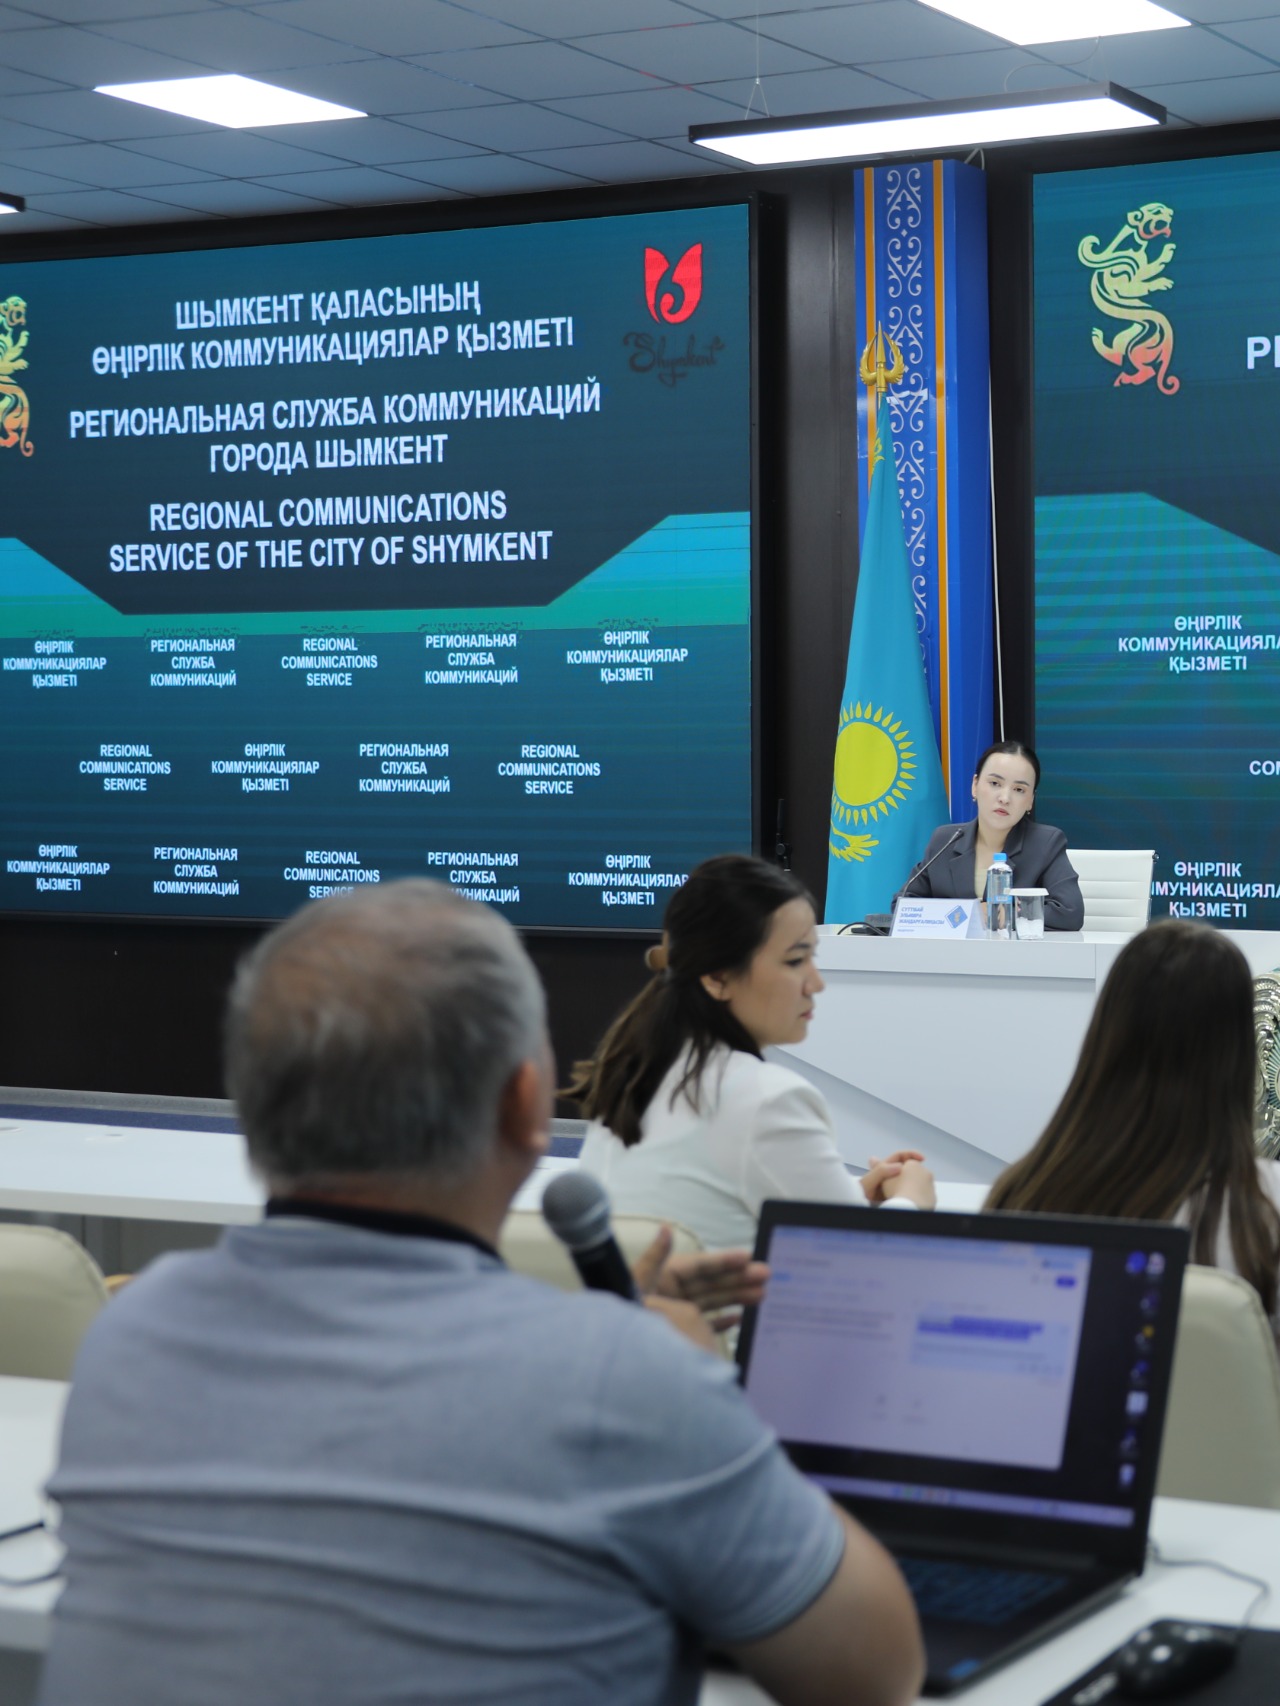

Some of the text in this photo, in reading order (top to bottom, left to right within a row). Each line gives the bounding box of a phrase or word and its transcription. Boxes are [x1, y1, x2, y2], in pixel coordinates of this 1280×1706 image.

[175, 280, 482, 330] ШЫМКЕНТ ҚАЛАСЫНЫҢ
[92, 316, 573, 378] ӨҢІРЛІК КОММУНИКАЦИЯЛАР ҚЫЗМЕТІ
[70, 376, 601, 439] РЕГИОНАЛЬНАЯ СЛУЖБА КОММУНИКАЦИЙ
[210, 433, 449, 476] ГОРОДА ШЫМКЕНТ
[150, 489, 507, 532] REGIONAL COMMUNICATIONS
[109, 530, 554, 573] SERVICE OF THE CITY OF SHYMKENT
[1174, 614, 1243, 633] ӨҢІРЛІК
[150, 638, 236, 653] РЕГИОНАЛЬНАЯ
[303, 637, 359, 652] REGIONAL
[425, 633, 517, 649] РЕГИОНАЛЬНАЯ
[603, 630, 650, 647] ӨҢІРЛІК
[34, 640, 74, 656] ӨҢІРЛІК
[566, 647, 689, 665] КОММУНИКАЦИЯЛАР
[3, 656, 107, 672] КОММУНИКАЦИЯЛАР
[171, 655, 216, 670] СЛУЖБА
[281, 654, 378, 670] COMMUNICATIONS
[447, 651, 496, 666] СЛУЖБА
[1169, 655, 1247, 674] ҚЫЗМЕТІ
[32, 673, 78, 689] ҚЫЗМЕТІ
[150, 669, 237, 688] КОММУНИКАЦИЙ
[306, 672, 353, 687] SERVICE
[425, 666, 518, 686] КОММУНИКАЦИЙ
[600, 667, 653, 684] ҚЫЗМЕТІ
[100, 744, 153, 758] REGIONAL
[244, 743, 286, 759] ӨҢІРЛІК
[359, 743, 449, 757] РЕГИОНАЛЬНАЯ
[521, 744, 580, 759] REGIONAL
[79, 760, 172, 775] COMMUNICATIONS
[211, 760, 320, 776] КОММУНИКАЦИЯЛАР
[381, 761, 428, 775] СЛУЖБА
[497, 762, 601, 777] COMMUNICATIONS
[103, 777, 147, 791] SERVICE
[241, 777, 290, 793] ҚЫЗМЕТІ
[359, 776, 451, 795] КОММУНИКАЦИЙ
[525, 780, 574, 795] SERVICE
[38, 844, 78, 859] ӨҢІРЛІК
[153, 846, 238, 861] РЕГИОНАЛЬНАЯ
[305, 850, 361, 865] REGIONAL
[427, 851, 519, 867] РЕГИОНАЛЬНАЯ
[6, 860, 111, 877] КОММУНИКАЦИЯЛАР
[174, 863, 219, 878] СЛУЖБА
[605, 854, 652, 871] ӨҢІРЛІК
[1174, 861, 1242, 879] ӨҢІРЛІК
[283, 867, 380, 882] COMMUNICATIONS
[450, 869, 497, 884] СЛУЖБА
[36, 877, 81, 892] ҚЫЗМЕТІ
[153, 879, 240, 897] КОММУНИКАЦИЙ
[602, 890, 655, 907] ҚЫЗМЕТІ
[1169, 902, 1247, 918] ҚЫЗМЕТІ
